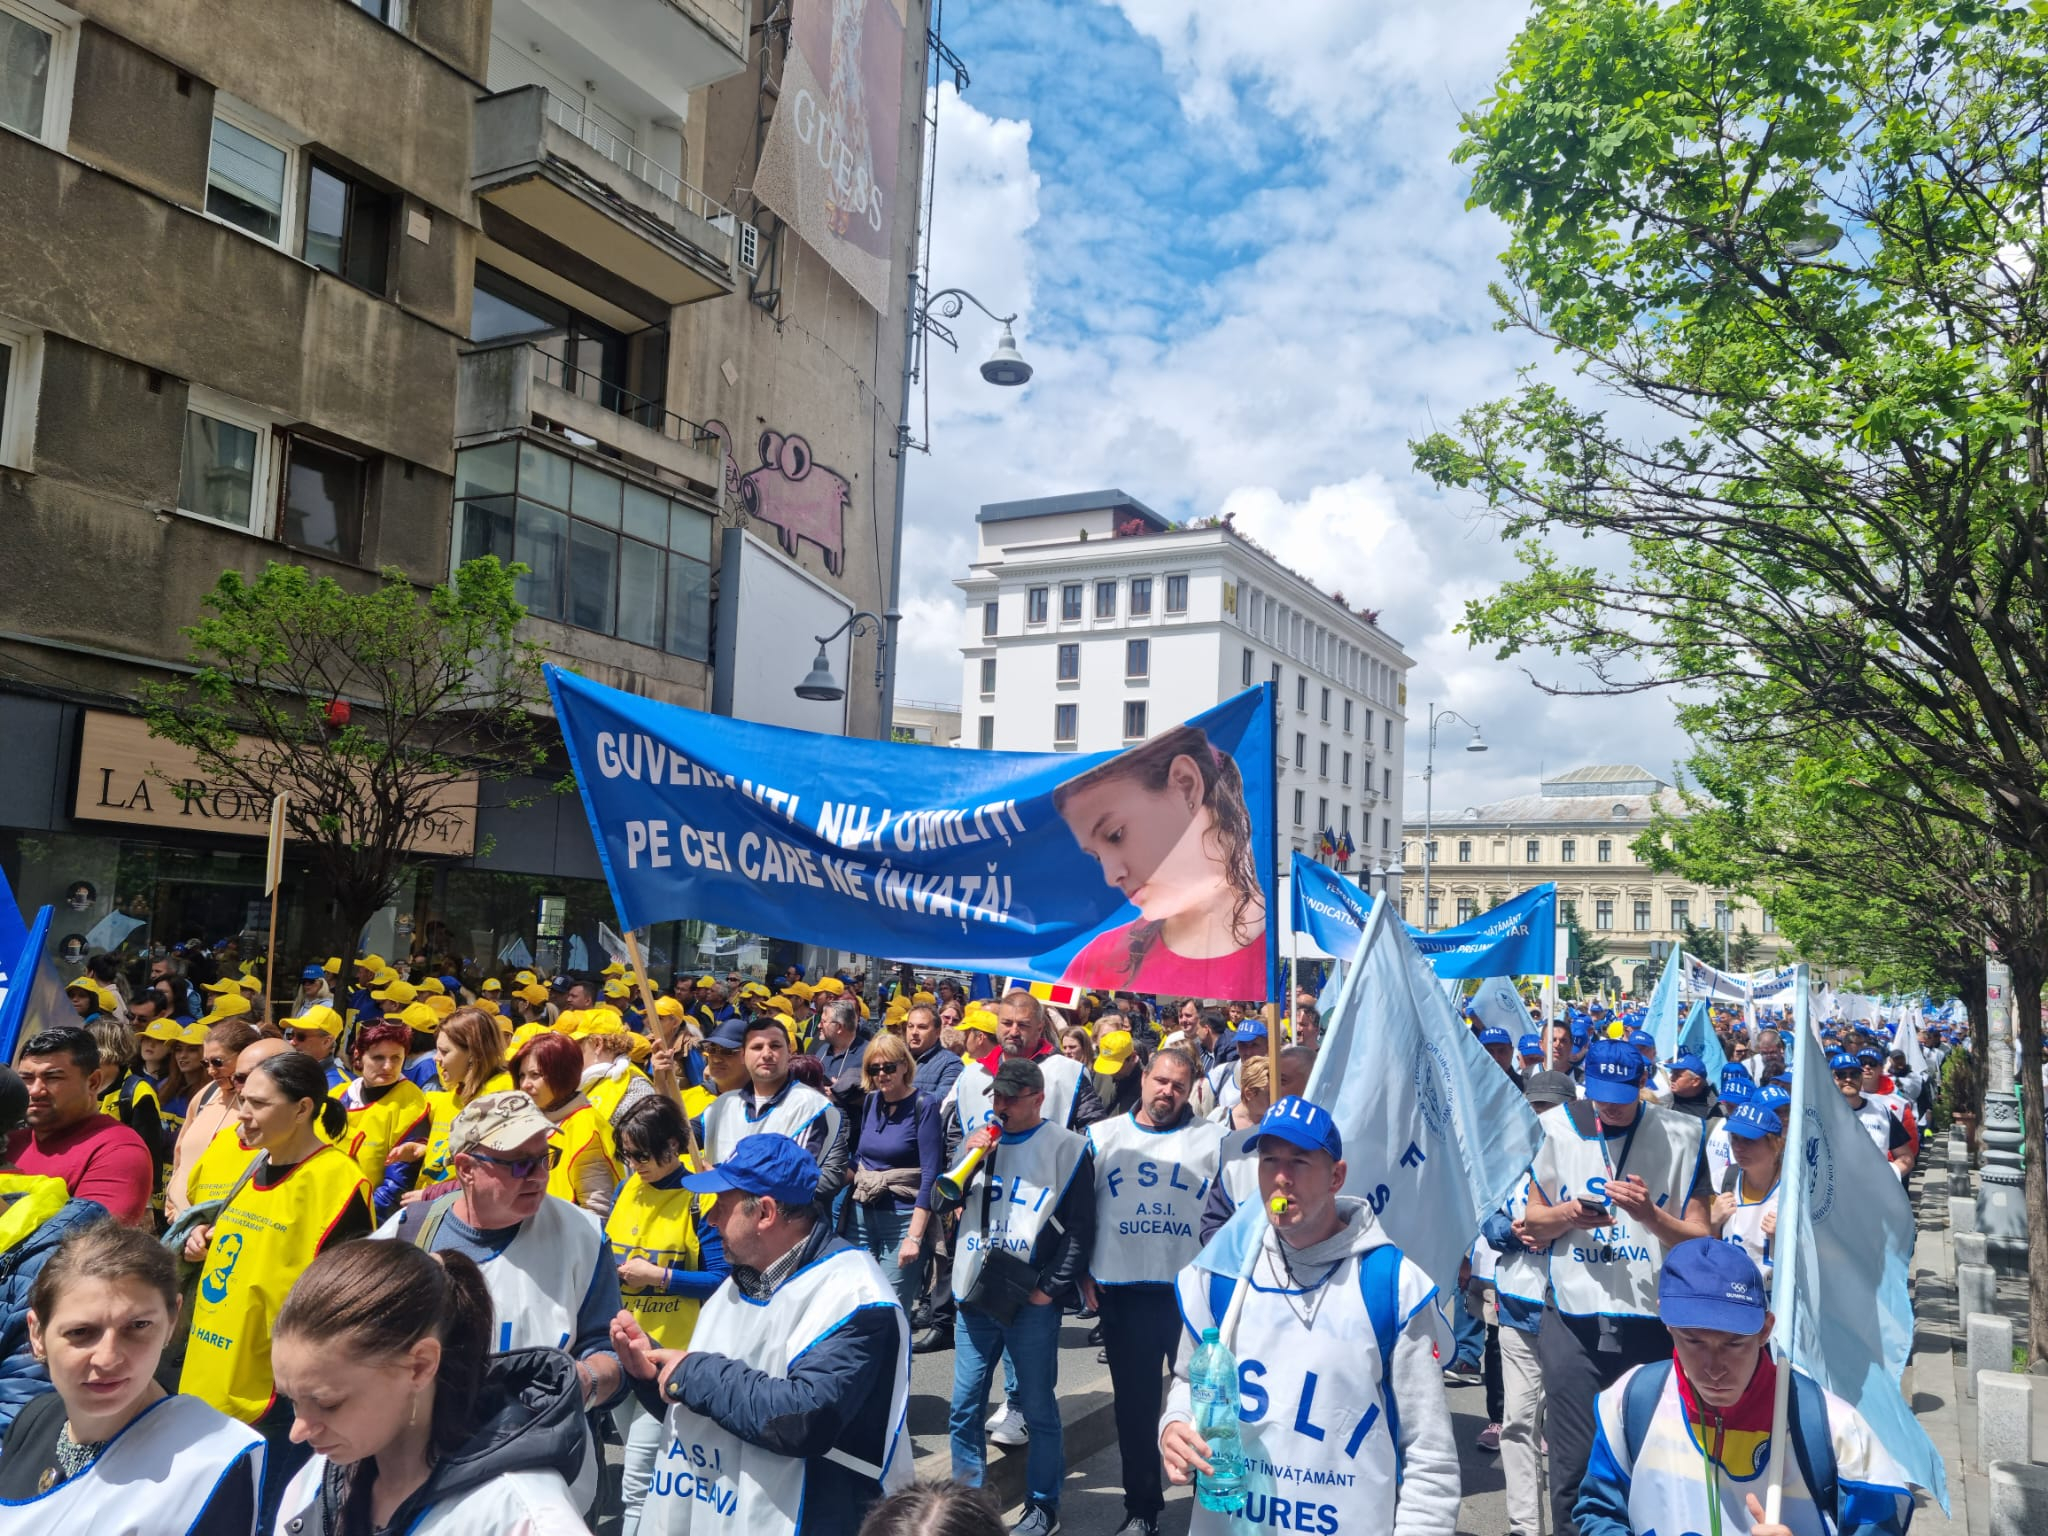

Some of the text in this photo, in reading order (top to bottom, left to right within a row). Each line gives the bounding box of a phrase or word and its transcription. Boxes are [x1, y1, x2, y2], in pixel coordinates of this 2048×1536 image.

[793, 88, 883, 233] GUESS
[96, 767, 155, 812] LA
[625, 819, 672, 869] PE
[679, 824, 733, 873] CEI
[738, 831, 825, 889] CARE
[821, 853, 870, 901] NE
[1600, 1063, 1628, 1077] FSLI
[1725, 1082, 1747, 1096] FSLI
[1263, 1098, 1317, 1127] FSLI
[1735, 1105, 1763, 1125] FSLI
[989, 1175, 1050, 1213] SLI
[1106, 1161, 1209, 1201] FSLI
[1136, 1202, 1176, 1217] A.S.I.
[1119, 1220, 1193, 1238] SUCEAVA
[197, 1327, 233, 1351] HARET
[1237, 1358, 1381, 1460] SLI
[667, 1437, 723, 1474] A.S.I.
